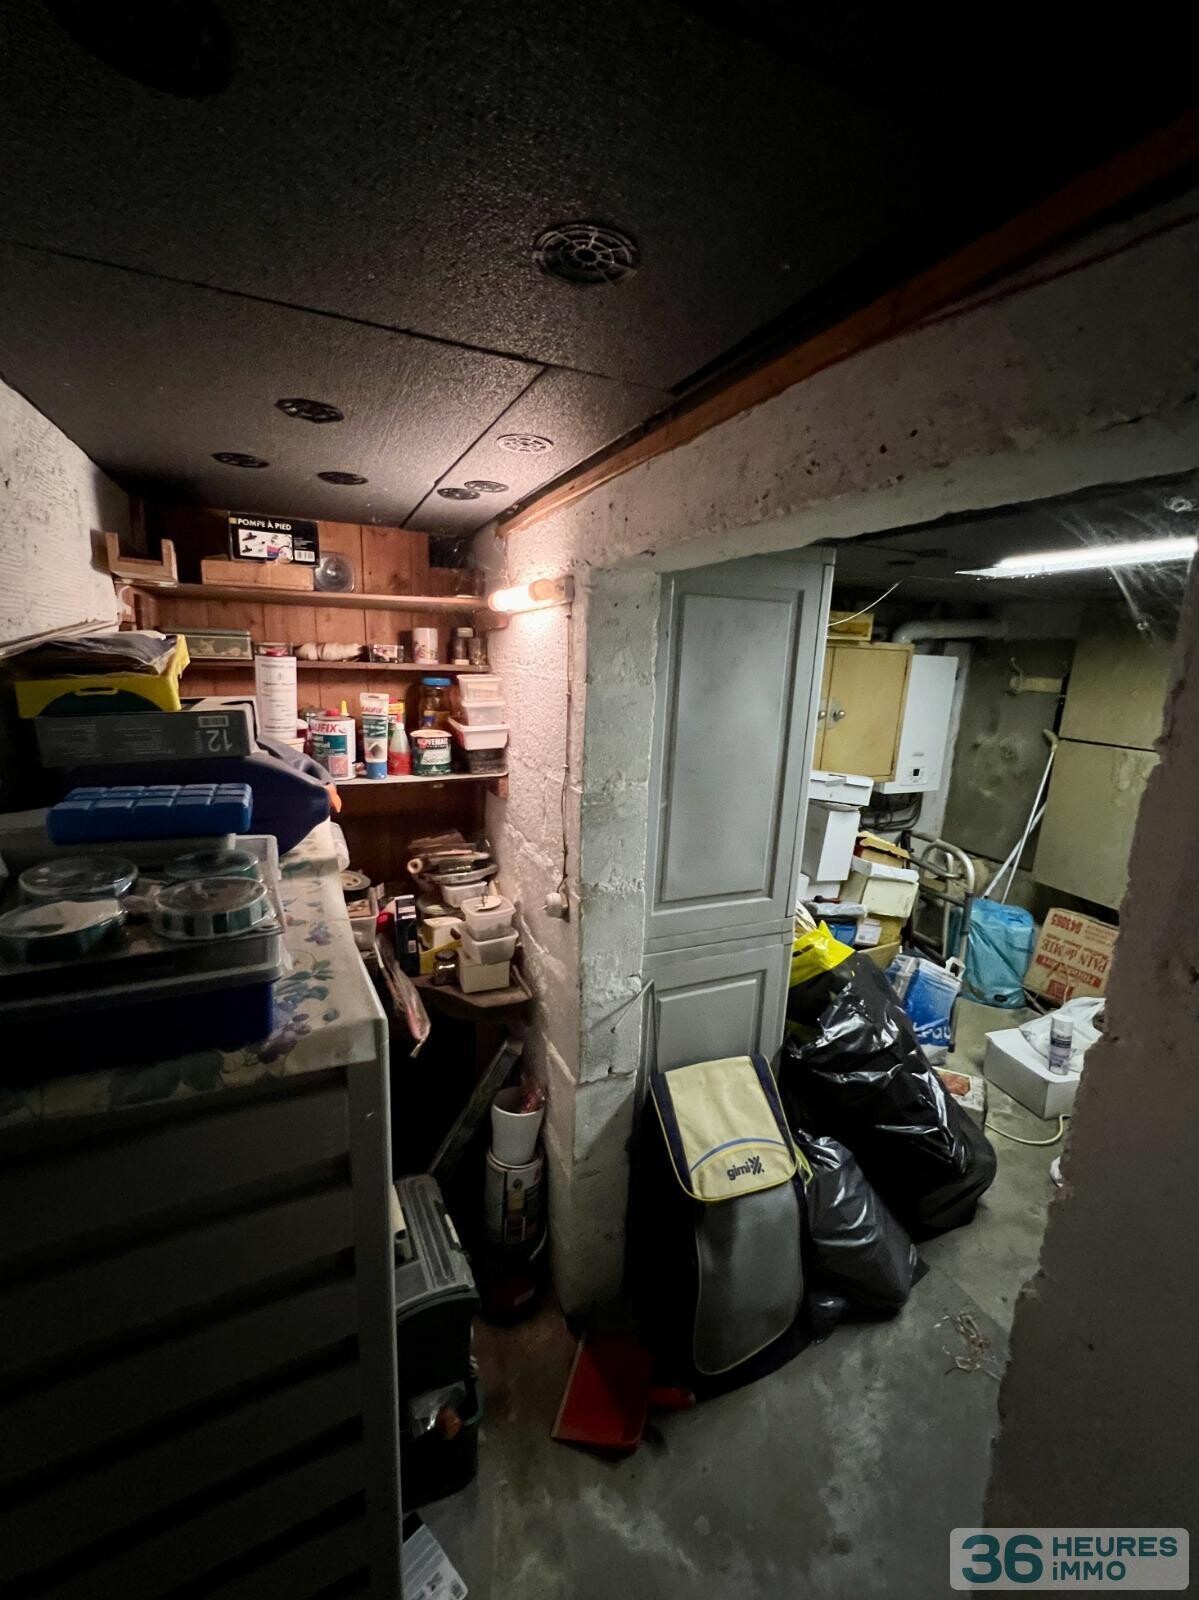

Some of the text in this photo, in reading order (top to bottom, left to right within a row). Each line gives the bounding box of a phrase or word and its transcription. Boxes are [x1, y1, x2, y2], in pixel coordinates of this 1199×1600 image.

[237, 518, 292, 531] POMPE À PIED
[205, 729, 233, 752] 12
[1041, 940, 1065, 956] MIE
[1081, 953, 1109, 973] PAIN
[727, 1162, 751, 1180] gimi
